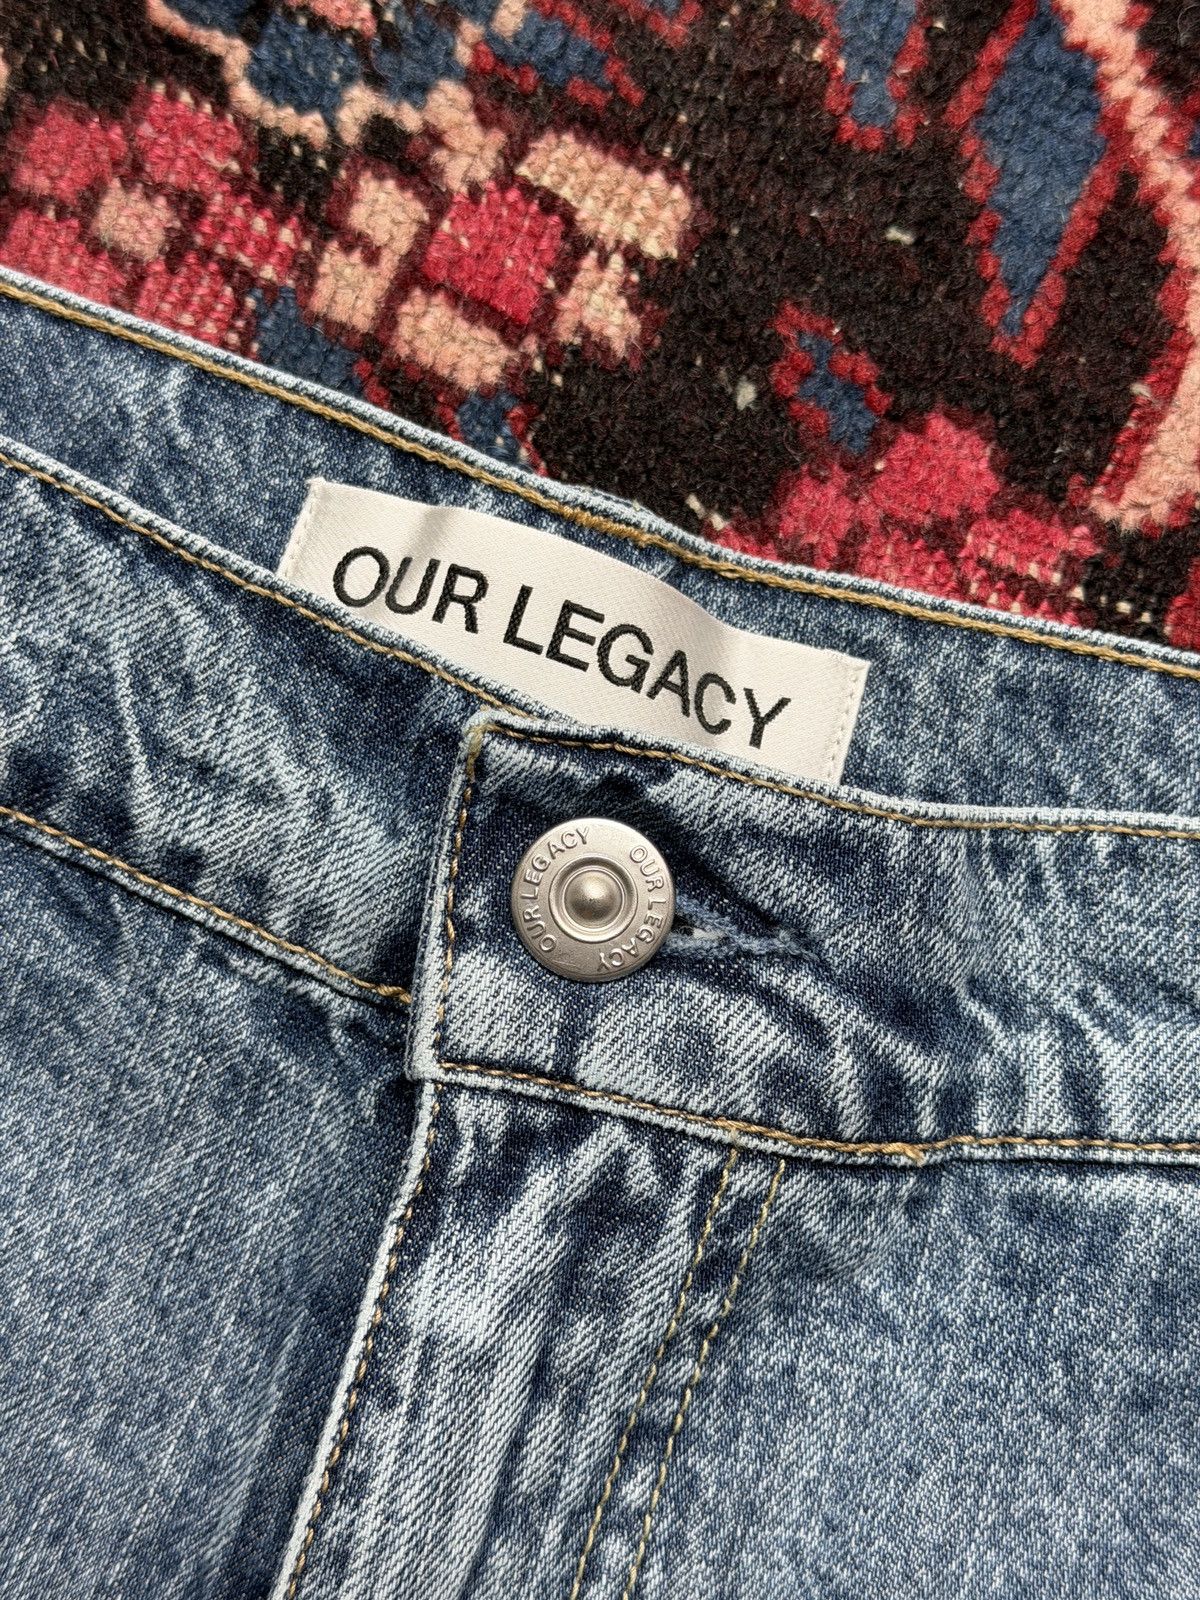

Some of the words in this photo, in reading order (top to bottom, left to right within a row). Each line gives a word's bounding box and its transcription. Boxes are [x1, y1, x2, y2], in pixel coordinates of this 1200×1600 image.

[333, 546, 489, 634] OUR
[503, 585, 791, 749] LEGACY
[521, 826, 590, 900] LEGACY
[630, 845, 664, 892] OUR
[522, 904, 557, 952] OUR
[597, 900, 667, 972] LEGACY
